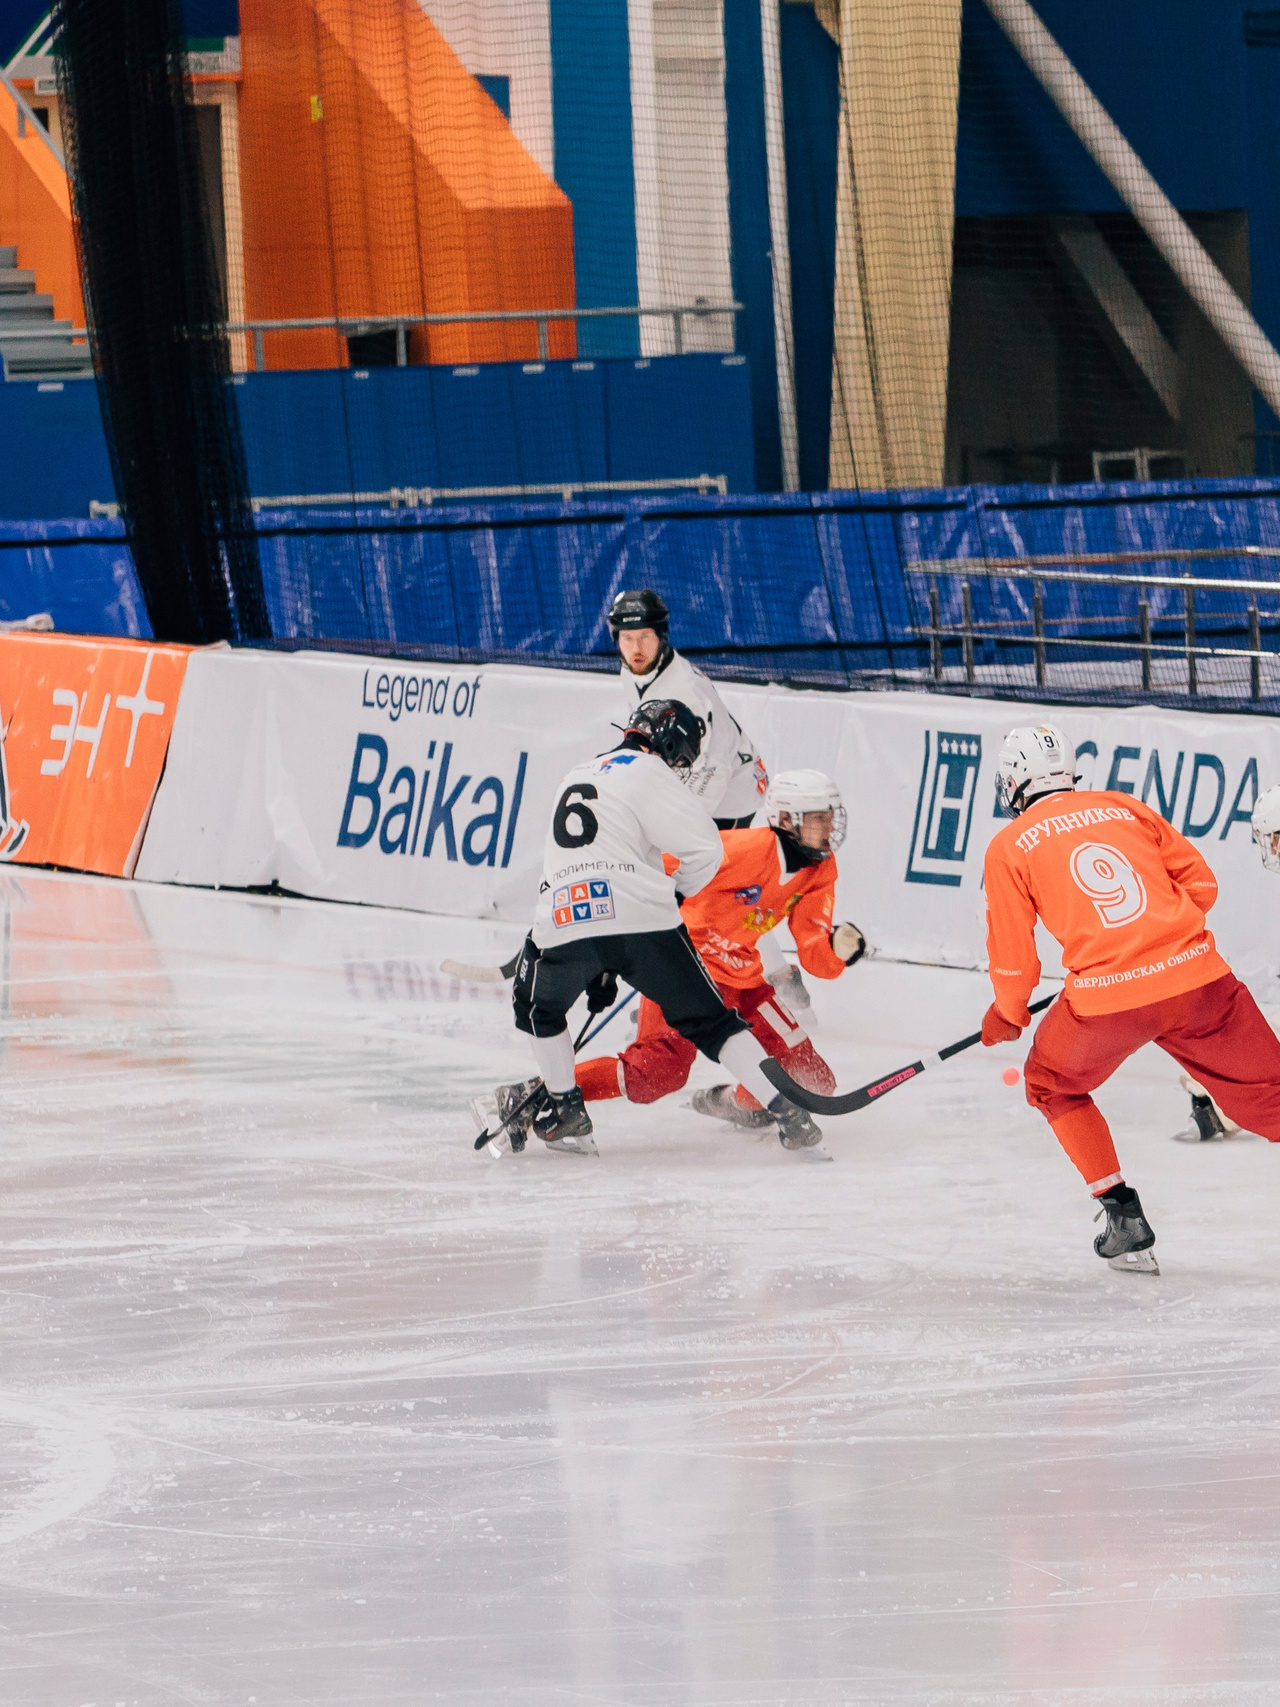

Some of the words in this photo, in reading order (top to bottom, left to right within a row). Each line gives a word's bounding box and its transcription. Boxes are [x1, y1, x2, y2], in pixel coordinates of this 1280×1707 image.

[362, 668, 450, 721] Legend
[453, 675, 482, 718] of
[1044, 735, 1055, 749] 9
[337, 732, 528, 869] Baikal
[553, 783, 599, 849] 6
[992, 733, 1259, 845] ENDA
[1069, 842, 1147, 929] 9
[1073, 961, 1166, 989] СВЕРДЛОВСКАЯ
